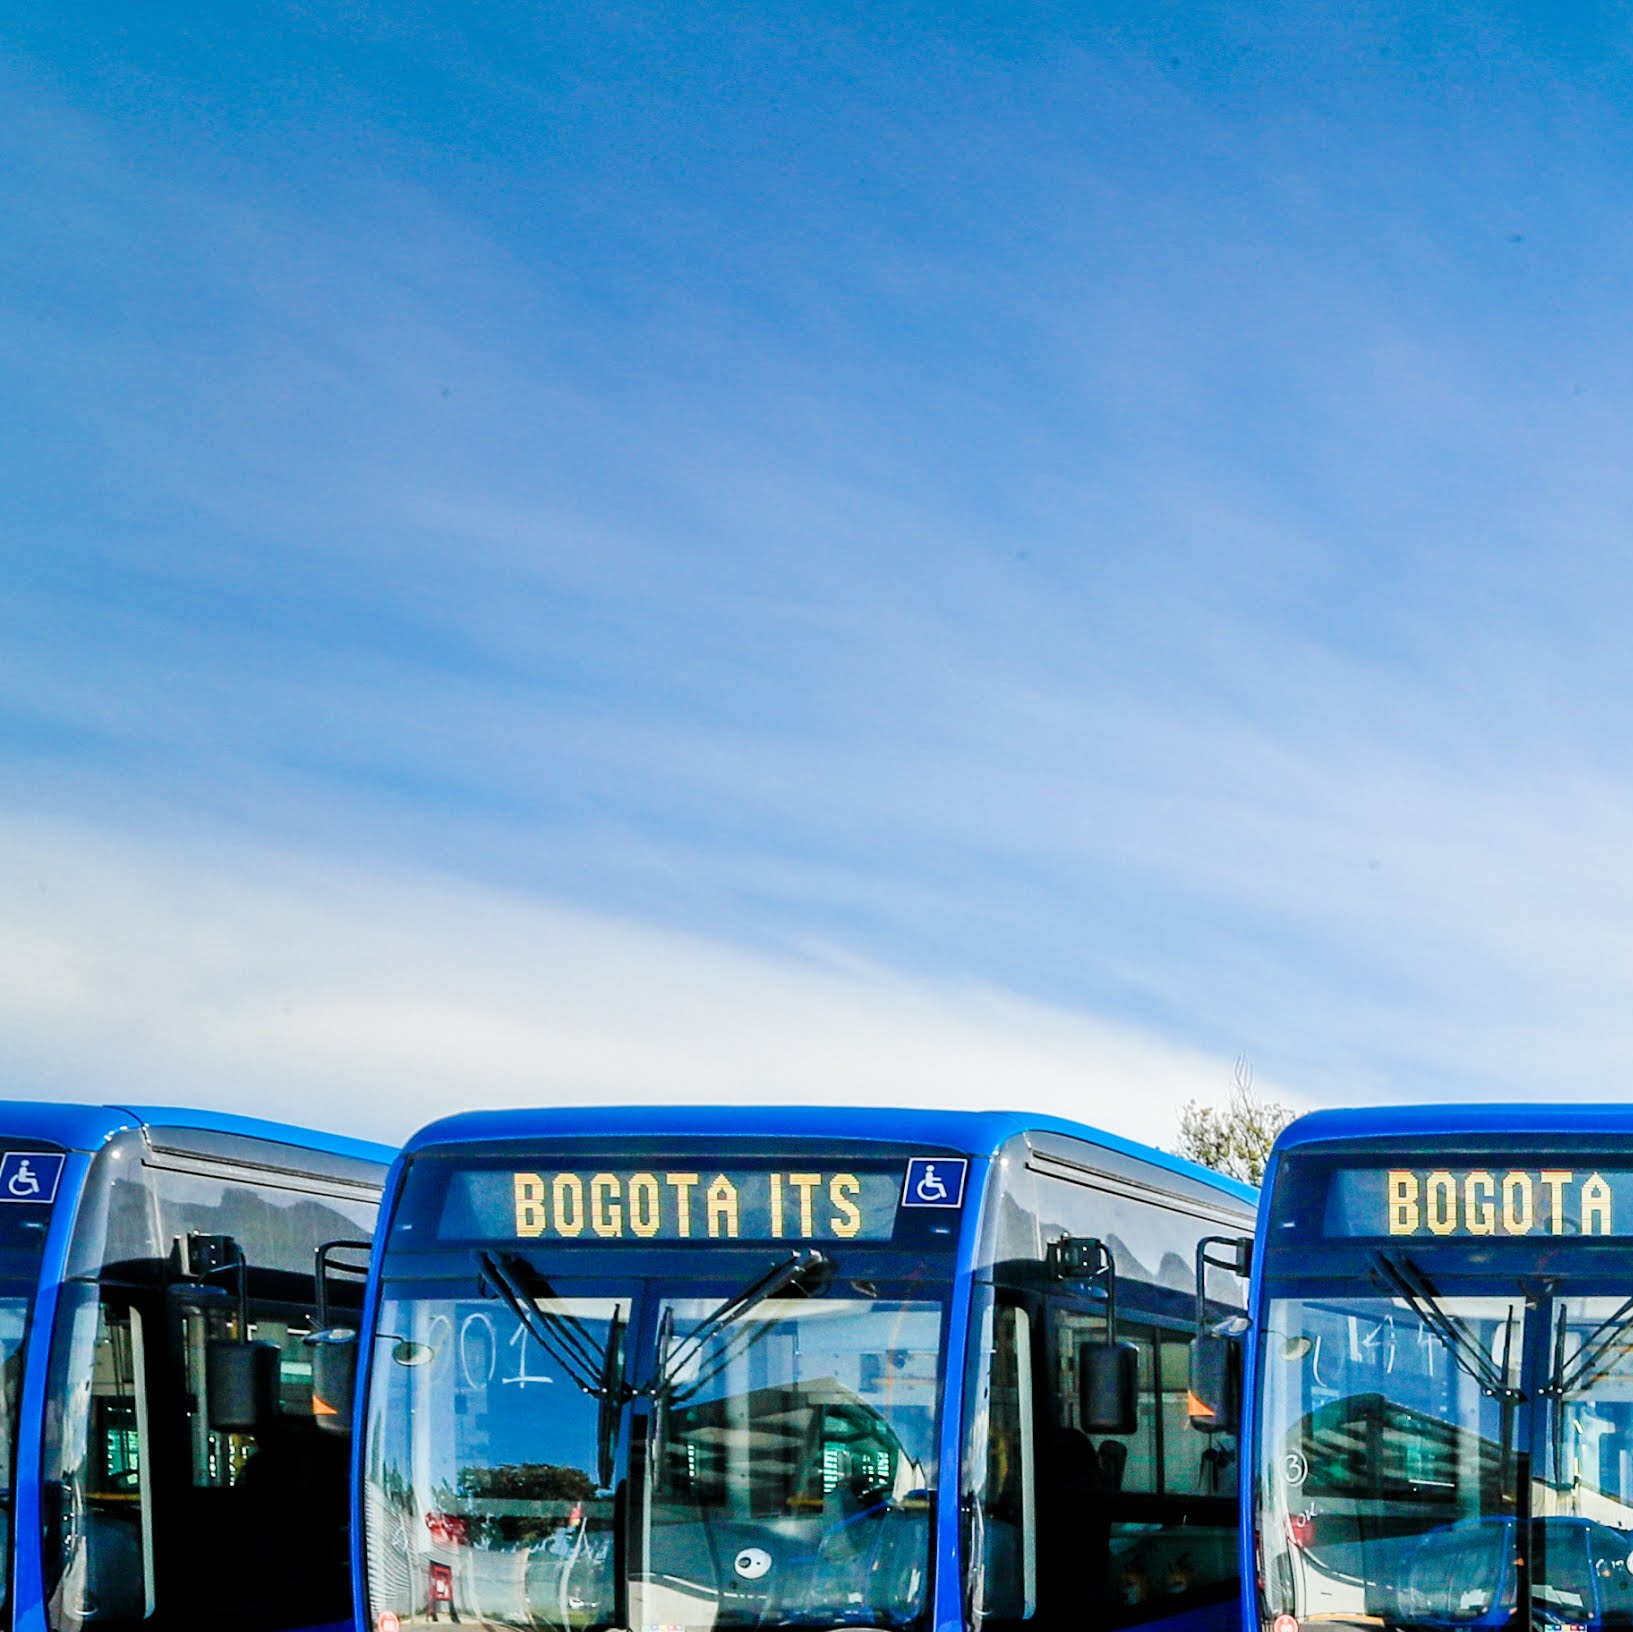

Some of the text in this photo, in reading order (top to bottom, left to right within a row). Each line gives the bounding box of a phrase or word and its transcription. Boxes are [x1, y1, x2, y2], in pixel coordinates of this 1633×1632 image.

[514, 1171, 862, 1239] BOGOTA ITS
[1387, 1168, 1613, 1237] BOGOTA
